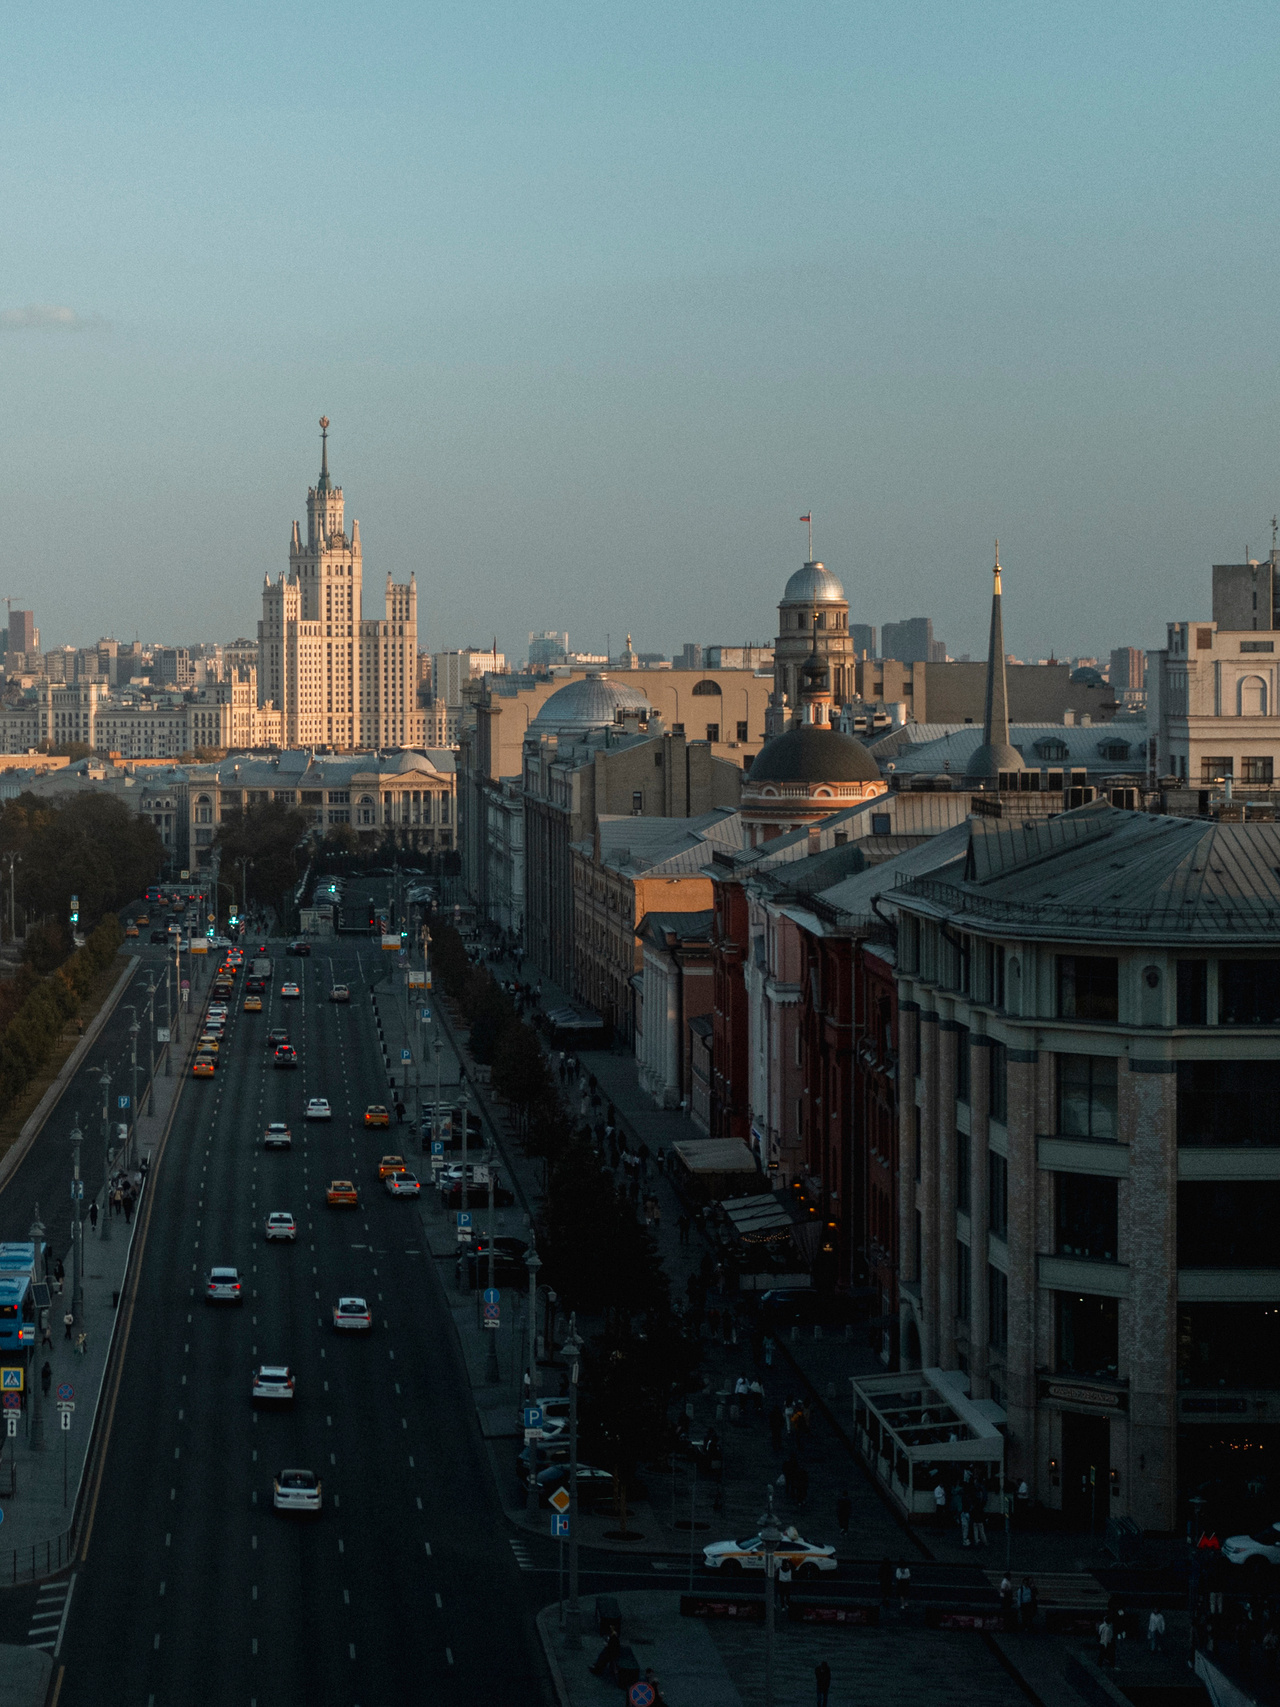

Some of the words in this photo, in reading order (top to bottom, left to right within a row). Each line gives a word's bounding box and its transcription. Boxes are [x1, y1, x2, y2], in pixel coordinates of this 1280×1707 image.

[434, 1143, 442, 1153] P
[461, 1214, 469, 1225] P
[530, 1410, 540, 1425] P
